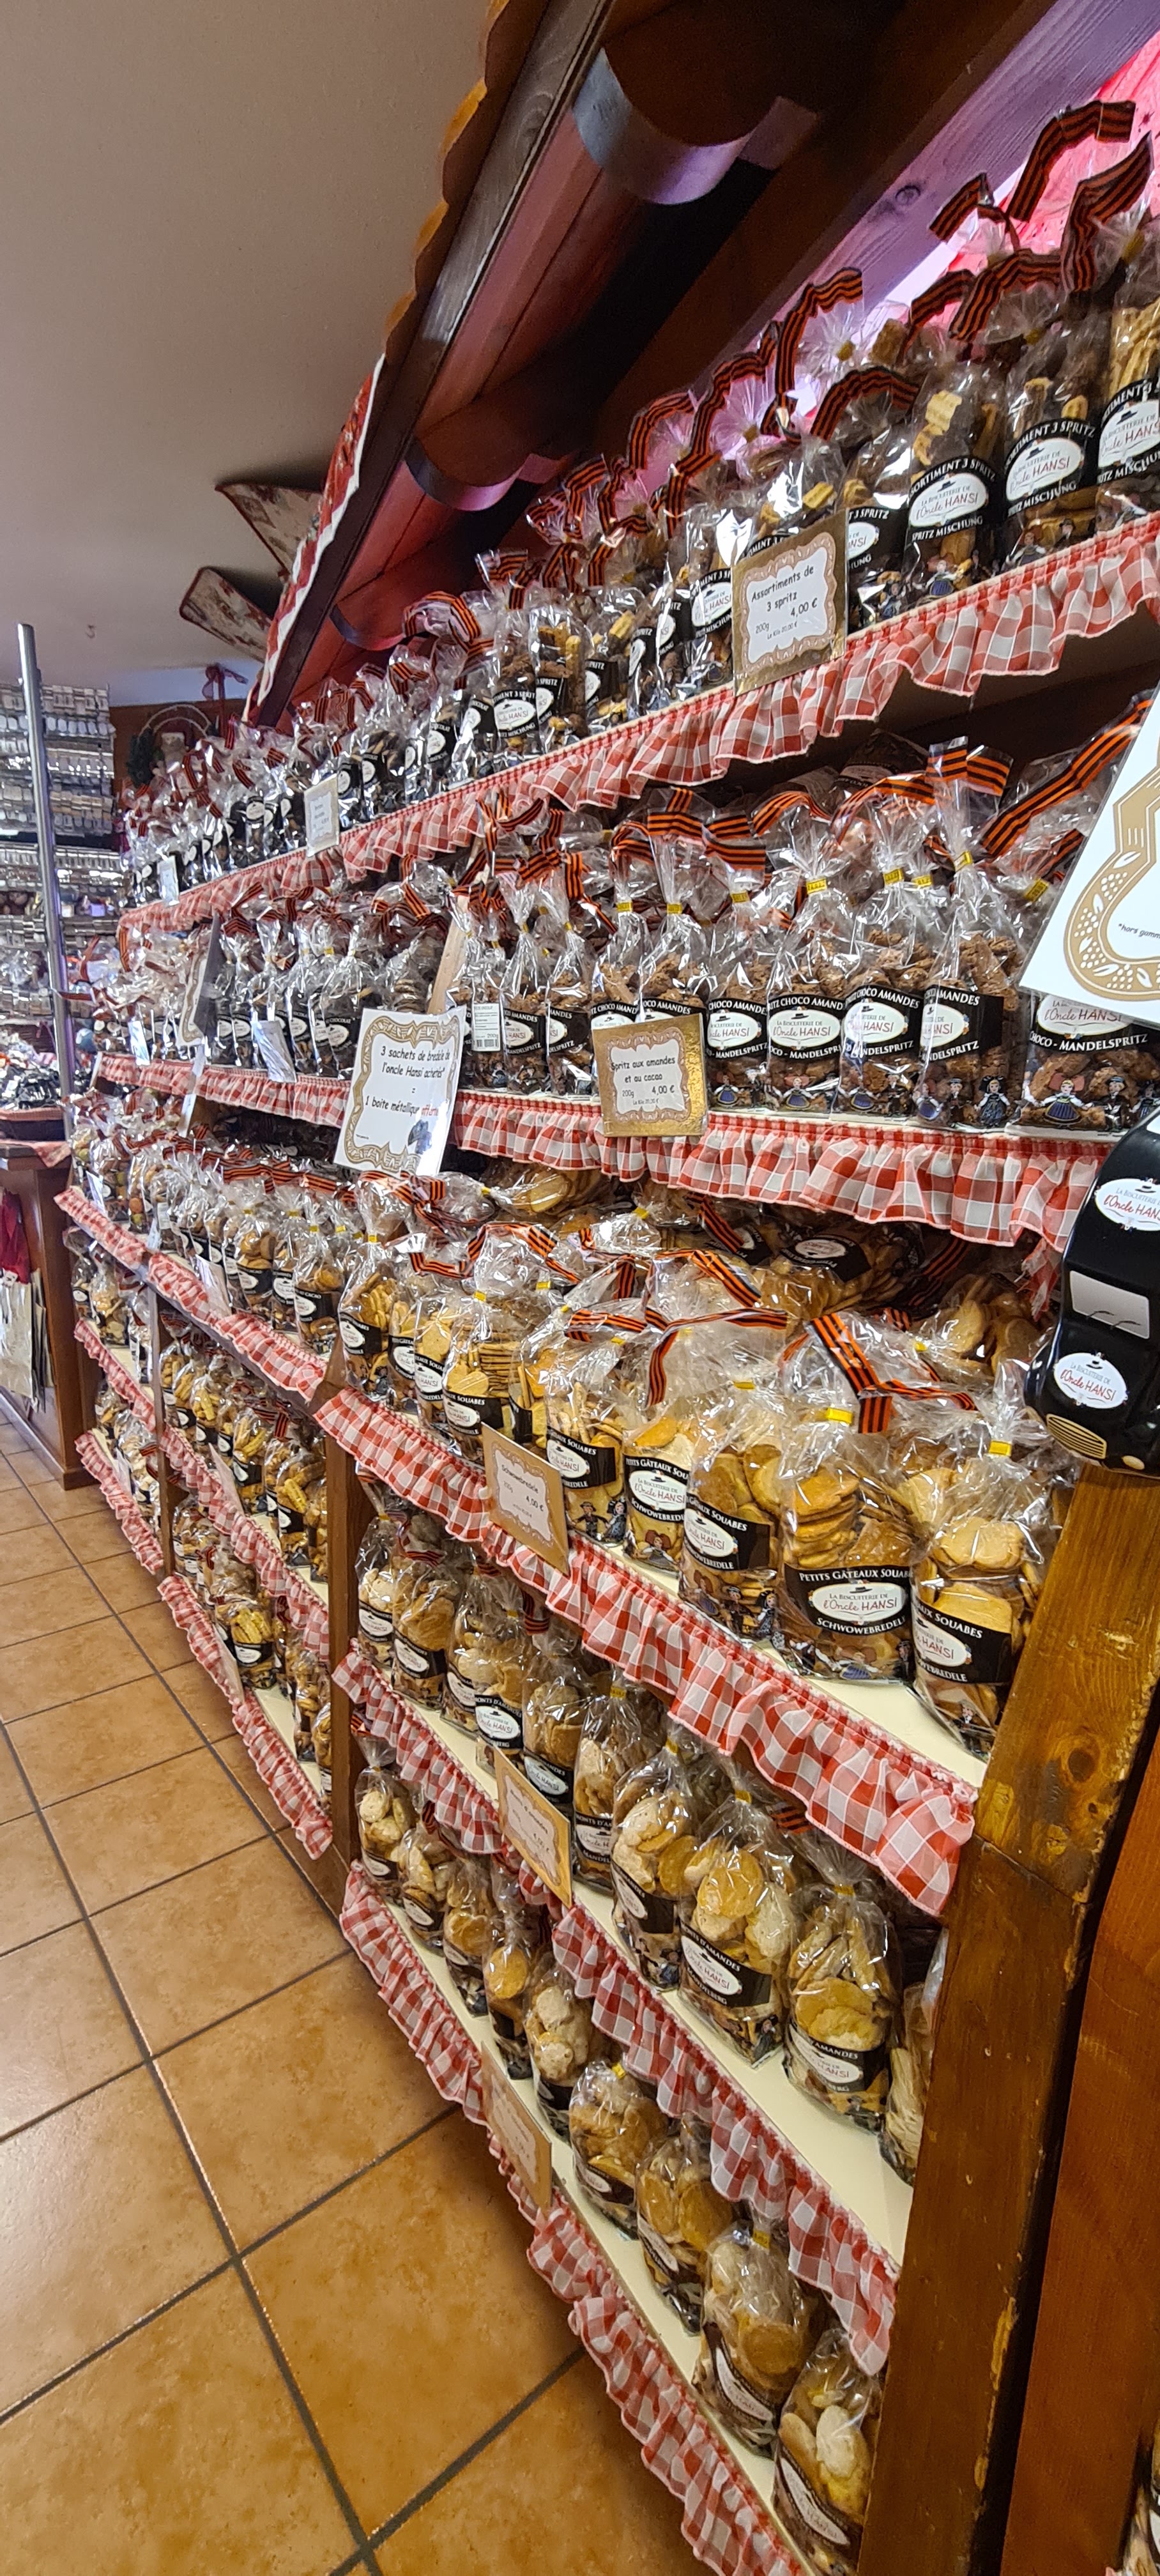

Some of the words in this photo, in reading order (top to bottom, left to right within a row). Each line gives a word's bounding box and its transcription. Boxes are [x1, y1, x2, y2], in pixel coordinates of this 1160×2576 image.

[1060, 421, 1096, 438] SPRITZ
[962, 459, 968, 468] 3
[970, 459, 996, 481] SPRITZ
[1032, 456, 1070, 477] HANSI
[945, 493, 977, 509] HANSI
[859, 509, 889, 519] SPRITZ
[912, 529, 934, 542] SPRITZ
[936, 516, 983, 539] MISCHUNG
[751, 572, 801, 602] Assortiments
[804, 565, 814, 577] de
[767, 601, 771, 611] 3
[774, 592, 797, 610] spritz
[791, 602, 809, 617] 4,00
[812, 597, 818, 608] €
[755, 622, 770, 634] 200g
[781, 996, 809, 1006] CHOCO
[878, 990, 920, 1009] AMANDES
[939, 990, 980, 1006] MANDES
[657, 1000, 691, 1015] AMANDES
[1044, 1008, 1078, 1020] l'Oncle
[722, 1028, 749, 1037] HANSI
[773, 1026, 798, 1036] l'Oncle
[800, 1027, 830, 1036] HANSI
[863, 1023, 894, 1032] HANSI
[862, 1040, 913, 1056] NDELSPRITZ
[1059, 1034, 1149, 1051] MANDELSPRITZ
[381, 1046, 386, 1055] 3
[388, 1048, 415, 1061] sachets
[418, 1050, 425, 1061] de
[382, 1062, 403, 1075] l'oncle
[406, 1066, 424, 1077] Hansi
[611, 1061, 630, 1073] Spritz
[646, 1055, 675, 1067] amandes
[644, 1073, 663, 1082] cacao
[622, 1089, 634, 1098] 200g
[652, 1086, 668, 1096] 4,00
[670, 1085, 675, 1093] €
[365, 1096, 369, 1105] 1
[1103, 1195, 1134, 1213] l'Oncle
[1060, 1369, 1084, 1388] l'Oncle
[1085, 1380, 1117, 1401] HANSI
[457, 1395, 485, 1406] SOUABES
[567, 1439, 597, 1455] SOUABES
[657, 1491, 685, 1503] HANSI
[711, 1510, 747, 1531] SOUABES
[701, 1533, 725, 1550] HANSI
[799, 1572, 830, 1581] PETITS
[832, 1569, 878, 1579] GÂTEAUX
[823, 1599, 859, 1611] l'Oncle
[862, 1597, 897, 1611] HANSI
[935, 1613, 983, 1639] SOUABES
[922, 1637, 954, 1659] HANSI
[492, 1723, 513, 1733] HANSI
[583, 1850, 610, 1864] MANDEL
[705, 1968, 729, 1990] HANSI
